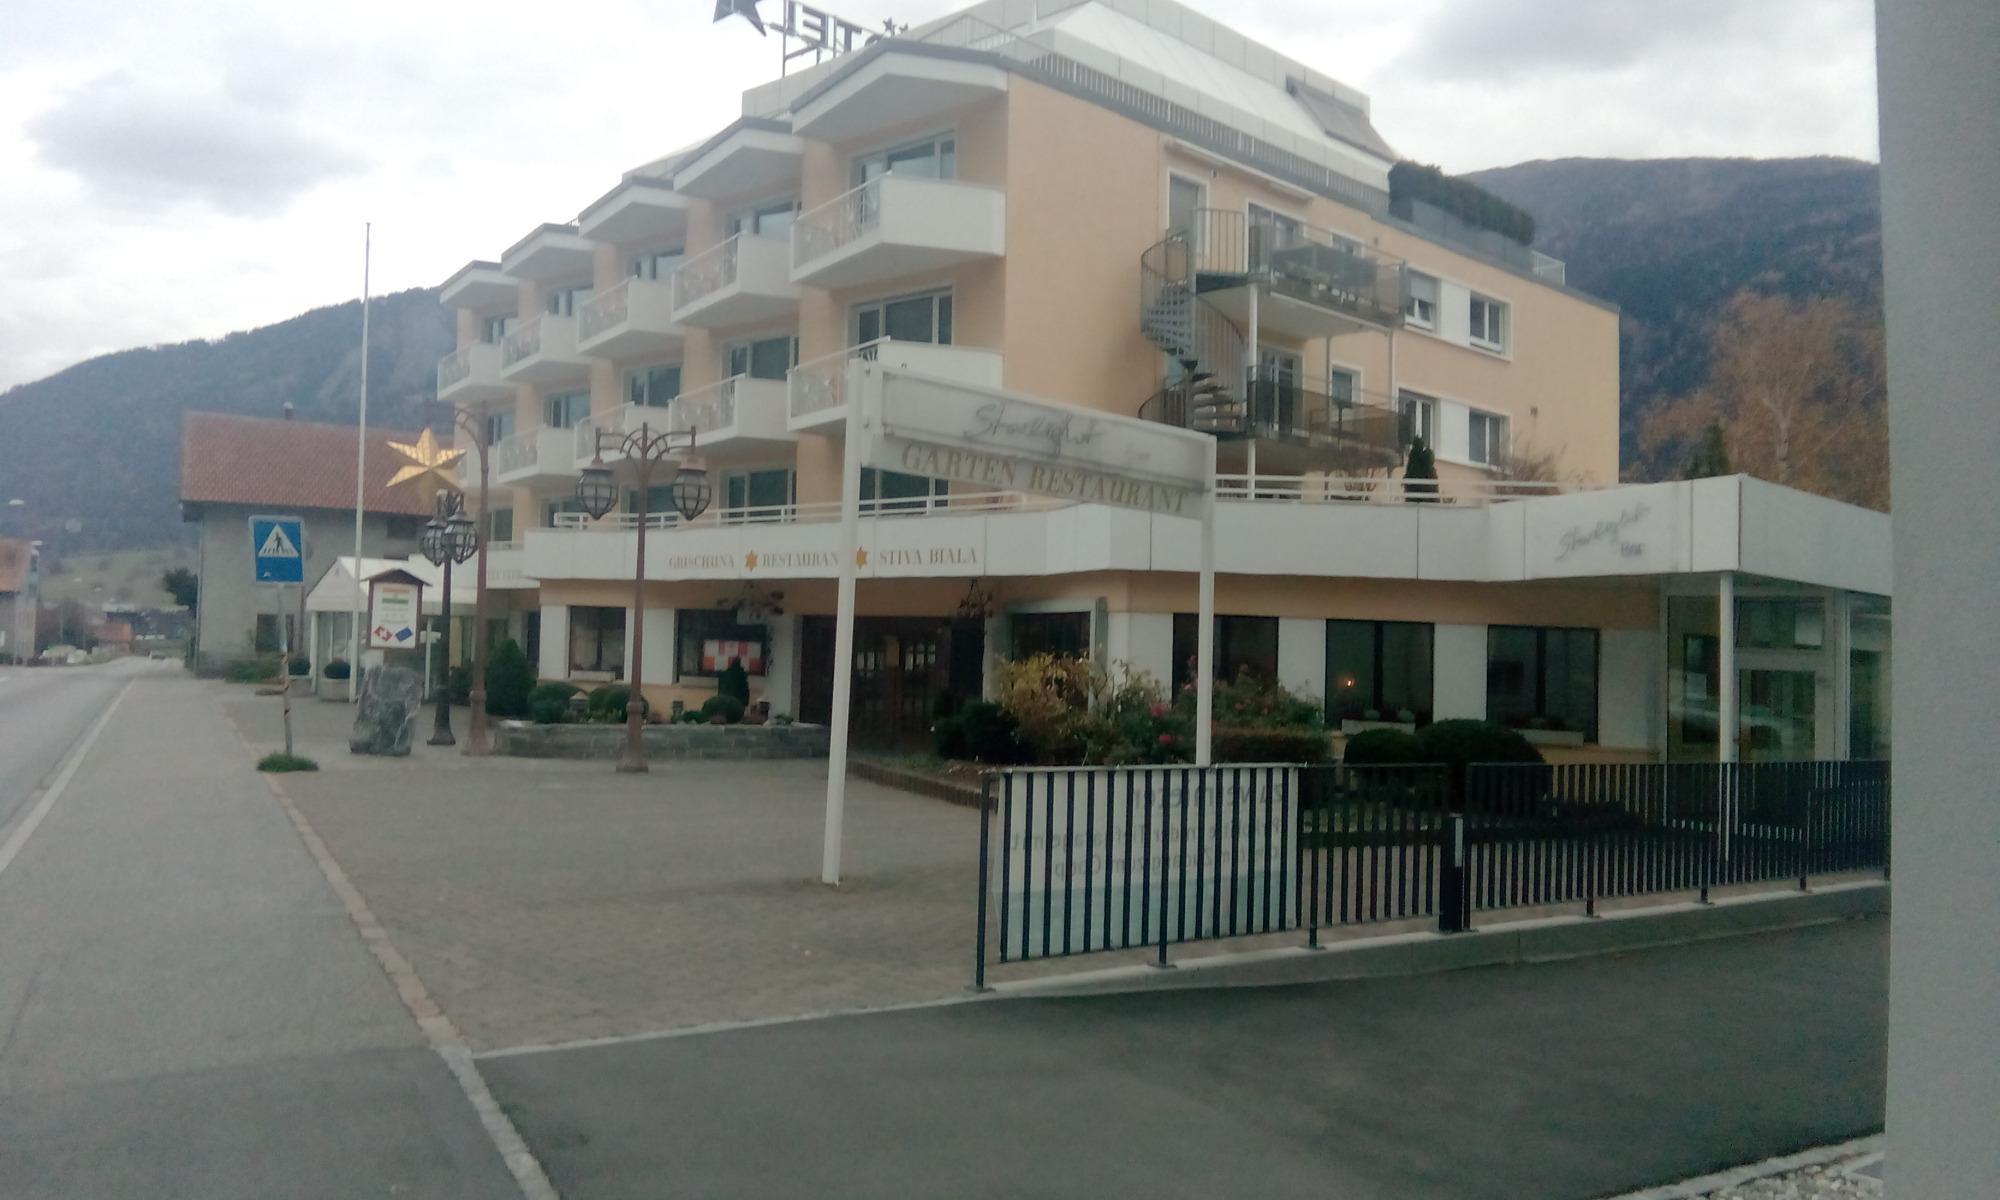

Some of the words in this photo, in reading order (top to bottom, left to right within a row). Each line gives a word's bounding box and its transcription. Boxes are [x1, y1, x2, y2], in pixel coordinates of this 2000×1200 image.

[902, 444, 1018, 487] GARTEN
[1029, 463, 1189, 513] RESTAURANT
[762, 551, 839, 568] RESTAURAN
[879, 549, 922, 566] STIVA
